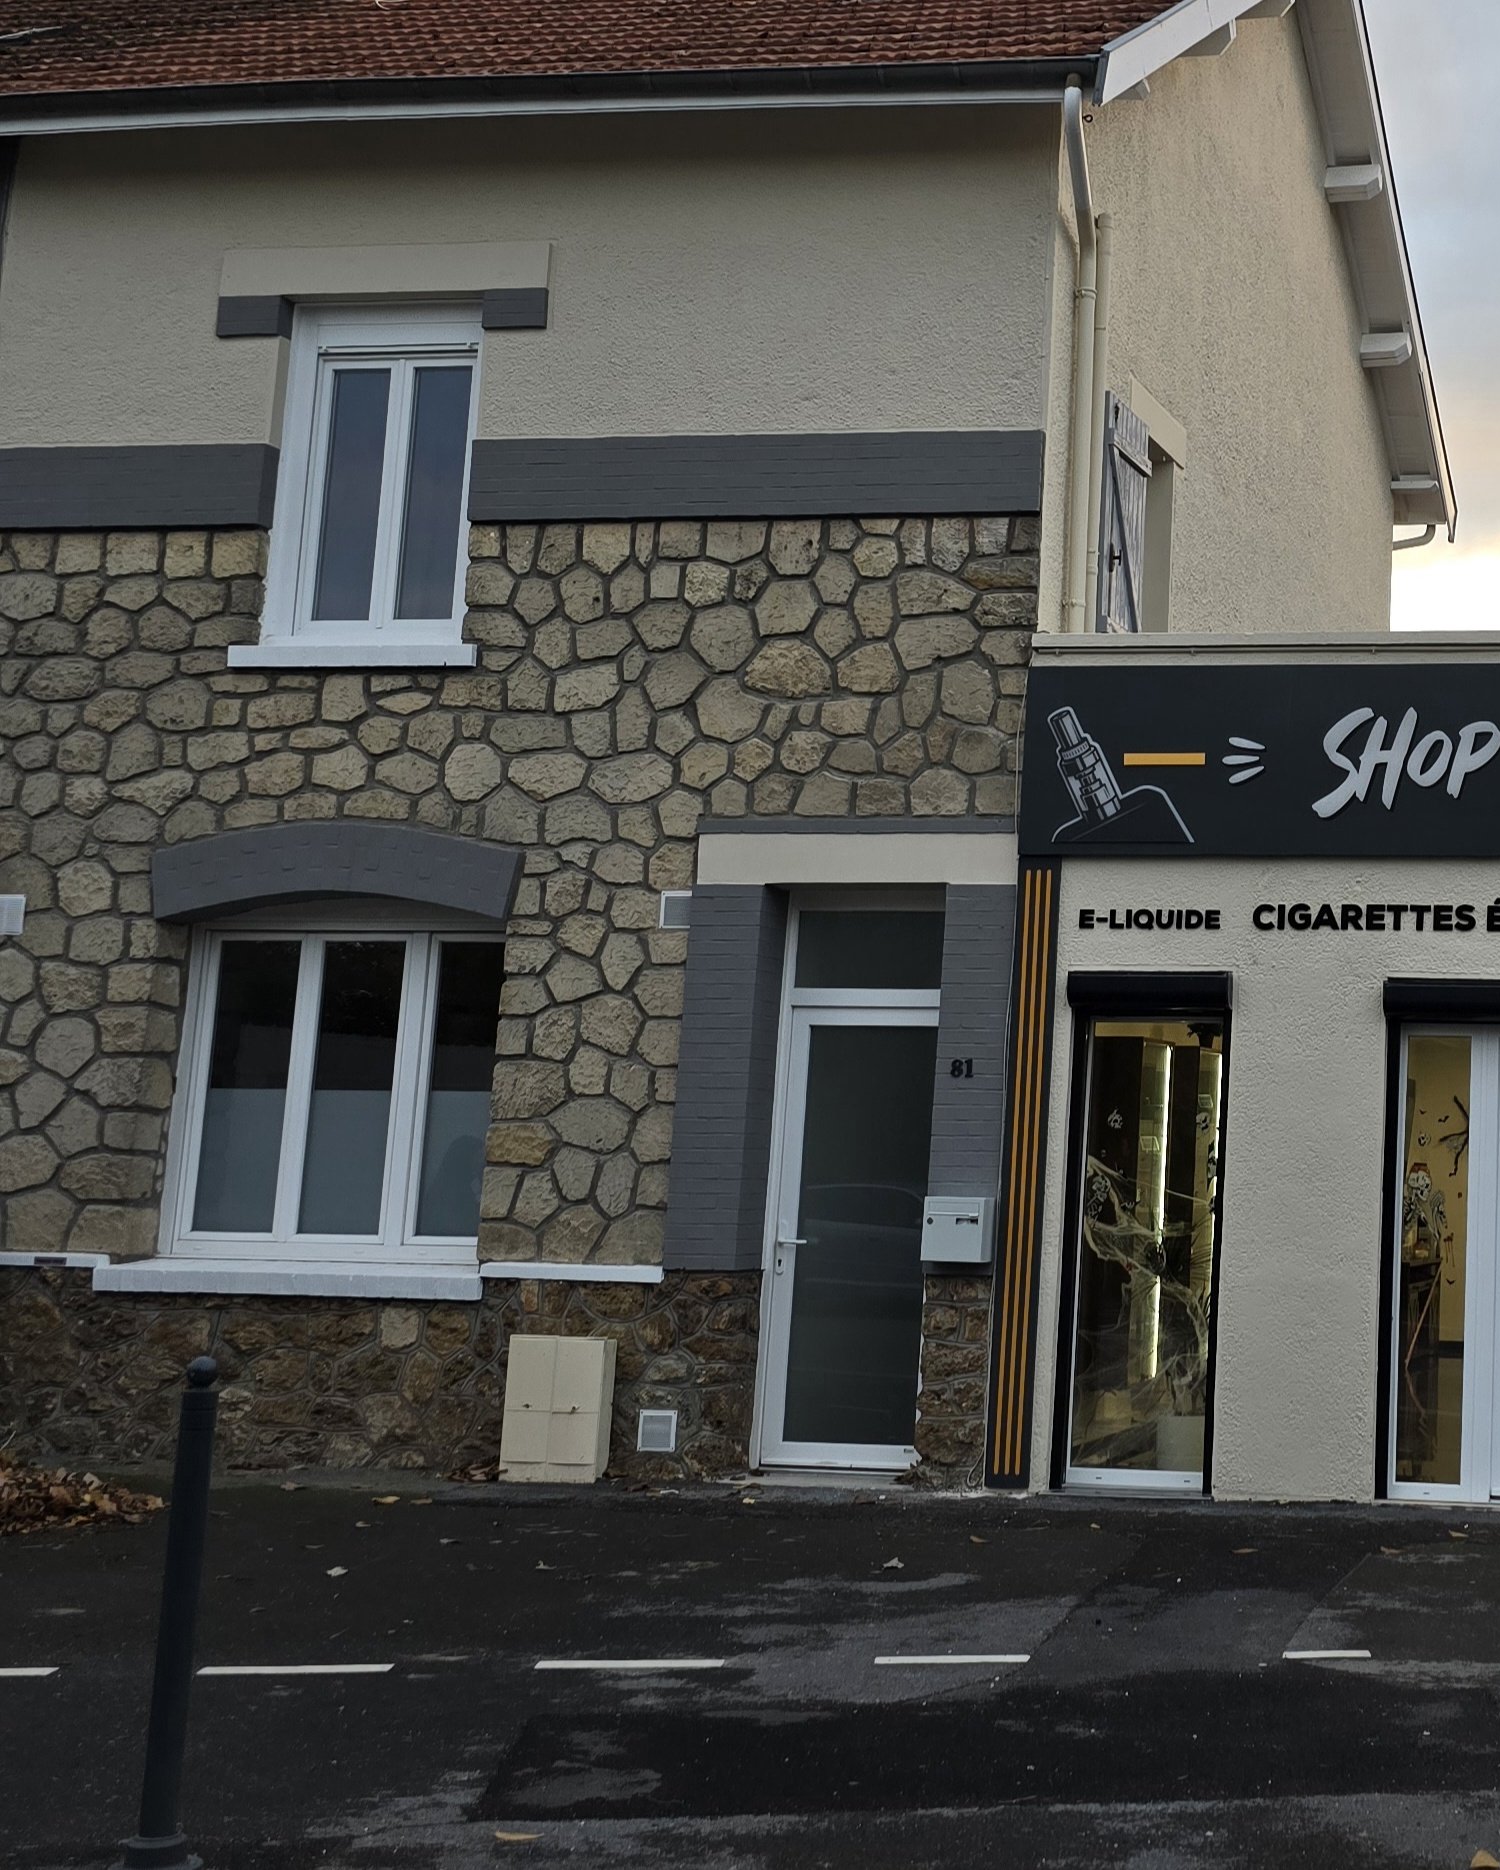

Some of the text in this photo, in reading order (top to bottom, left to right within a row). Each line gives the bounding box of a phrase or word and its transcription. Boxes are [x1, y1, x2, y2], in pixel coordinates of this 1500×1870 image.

[1078, 908, 1221, 930] E-LIQUIDE
[1252, 904, 1477, 932] CIGARETTES
[951, 1058, 974, 1078] 81
